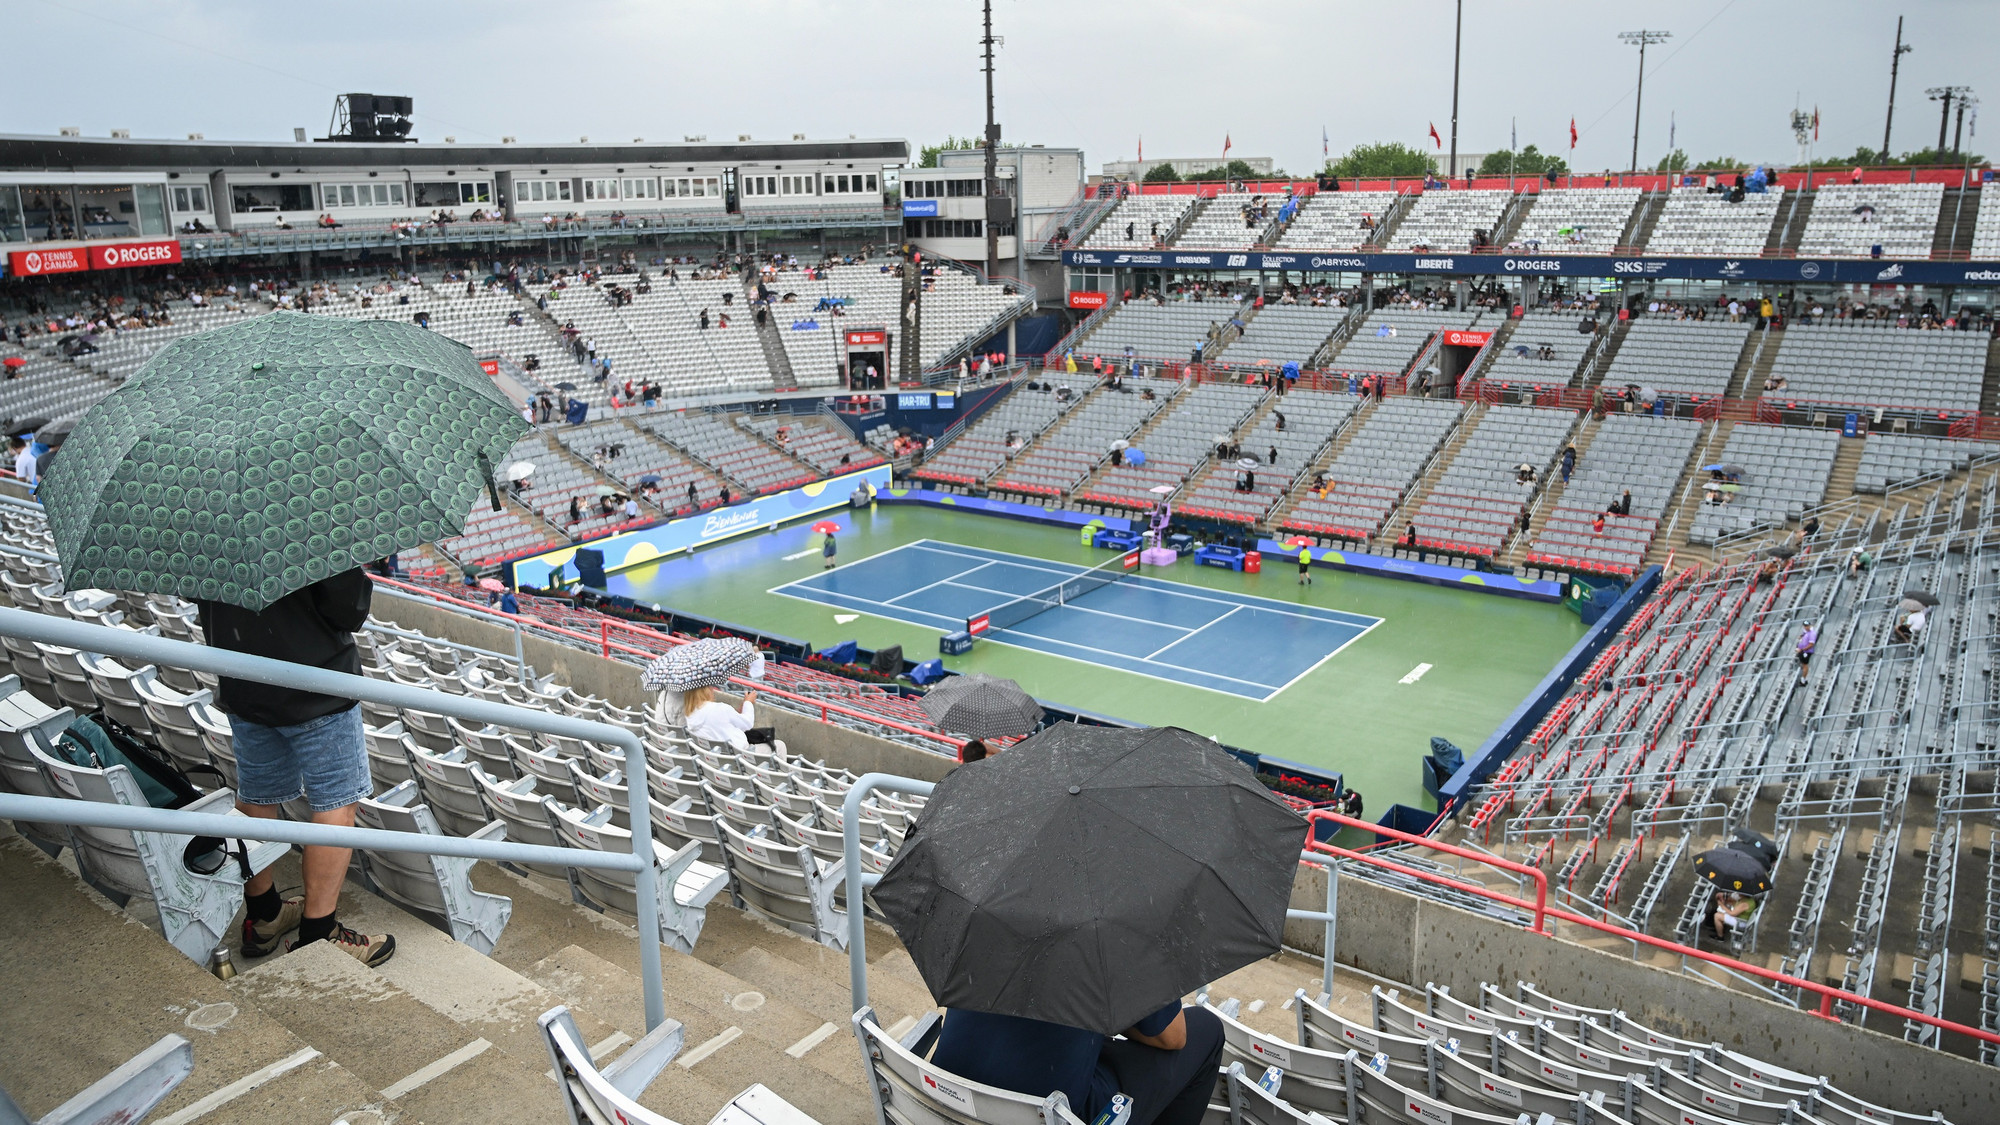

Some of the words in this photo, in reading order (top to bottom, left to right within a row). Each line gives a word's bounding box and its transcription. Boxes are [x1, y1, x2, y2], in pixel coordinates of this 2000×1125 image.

[42, 251, 74, 261] TENNIS
[121, 245, 172, 262] ROGERS
[43, 259, 79, 271] CANADA
[1175, 256, 1211, 265] BARBADOS
[1226, 254, 1248, 267] IGA
[1321, 257, 1361, 267] ABRYSVO
[1517, 260, 1561, 271] ROGERS
[1614, 261, 1643, 273] SKS
[1080, 297, 1103, 305] ROGERS
[899, 395, 930, 407] HAR-TRU
[937, 1083, 957, 1095] BANQUE
[938, 1087, 966, 1103] NATIONALE
